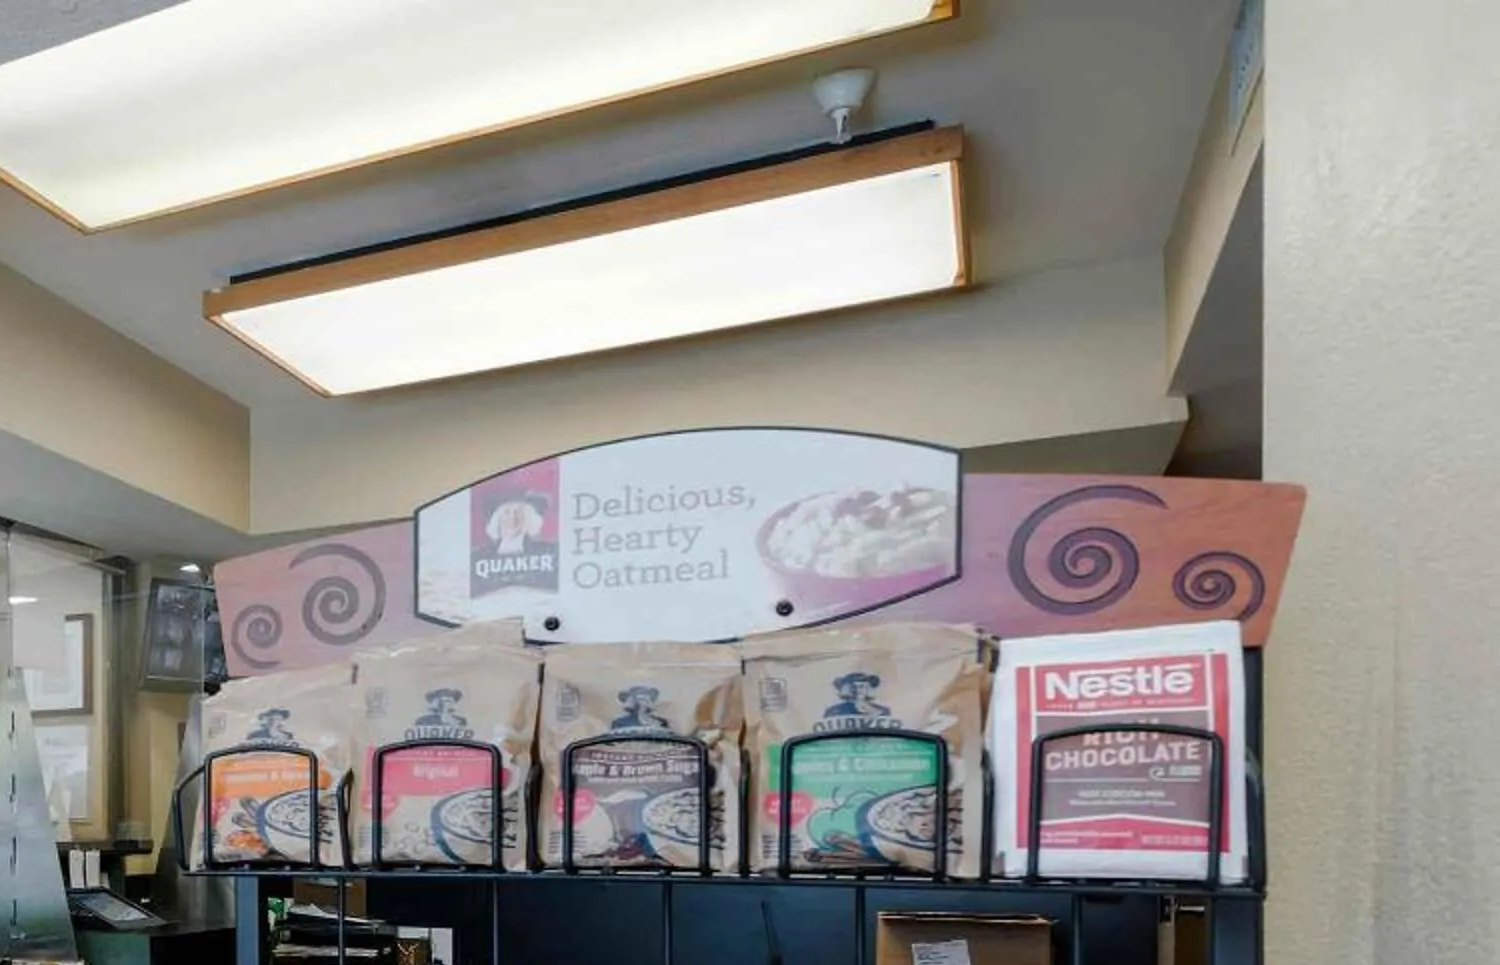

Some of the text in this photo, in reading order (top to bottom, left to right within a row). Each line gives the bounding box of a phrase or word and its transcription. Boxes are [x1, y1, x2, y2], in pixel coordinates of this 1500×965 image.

[571, 484, 757, 521] Delicious,
[571, 523, 704, 556] Hearty
[476, 554, 554, 579] QUAKER
[572, 547, 731, 589] Oatmeal
[573, 762, 606, 776] aple
[667, 759, 699, 775] Suga
[1045, 741, 1202, 771] CHOCOLATE
